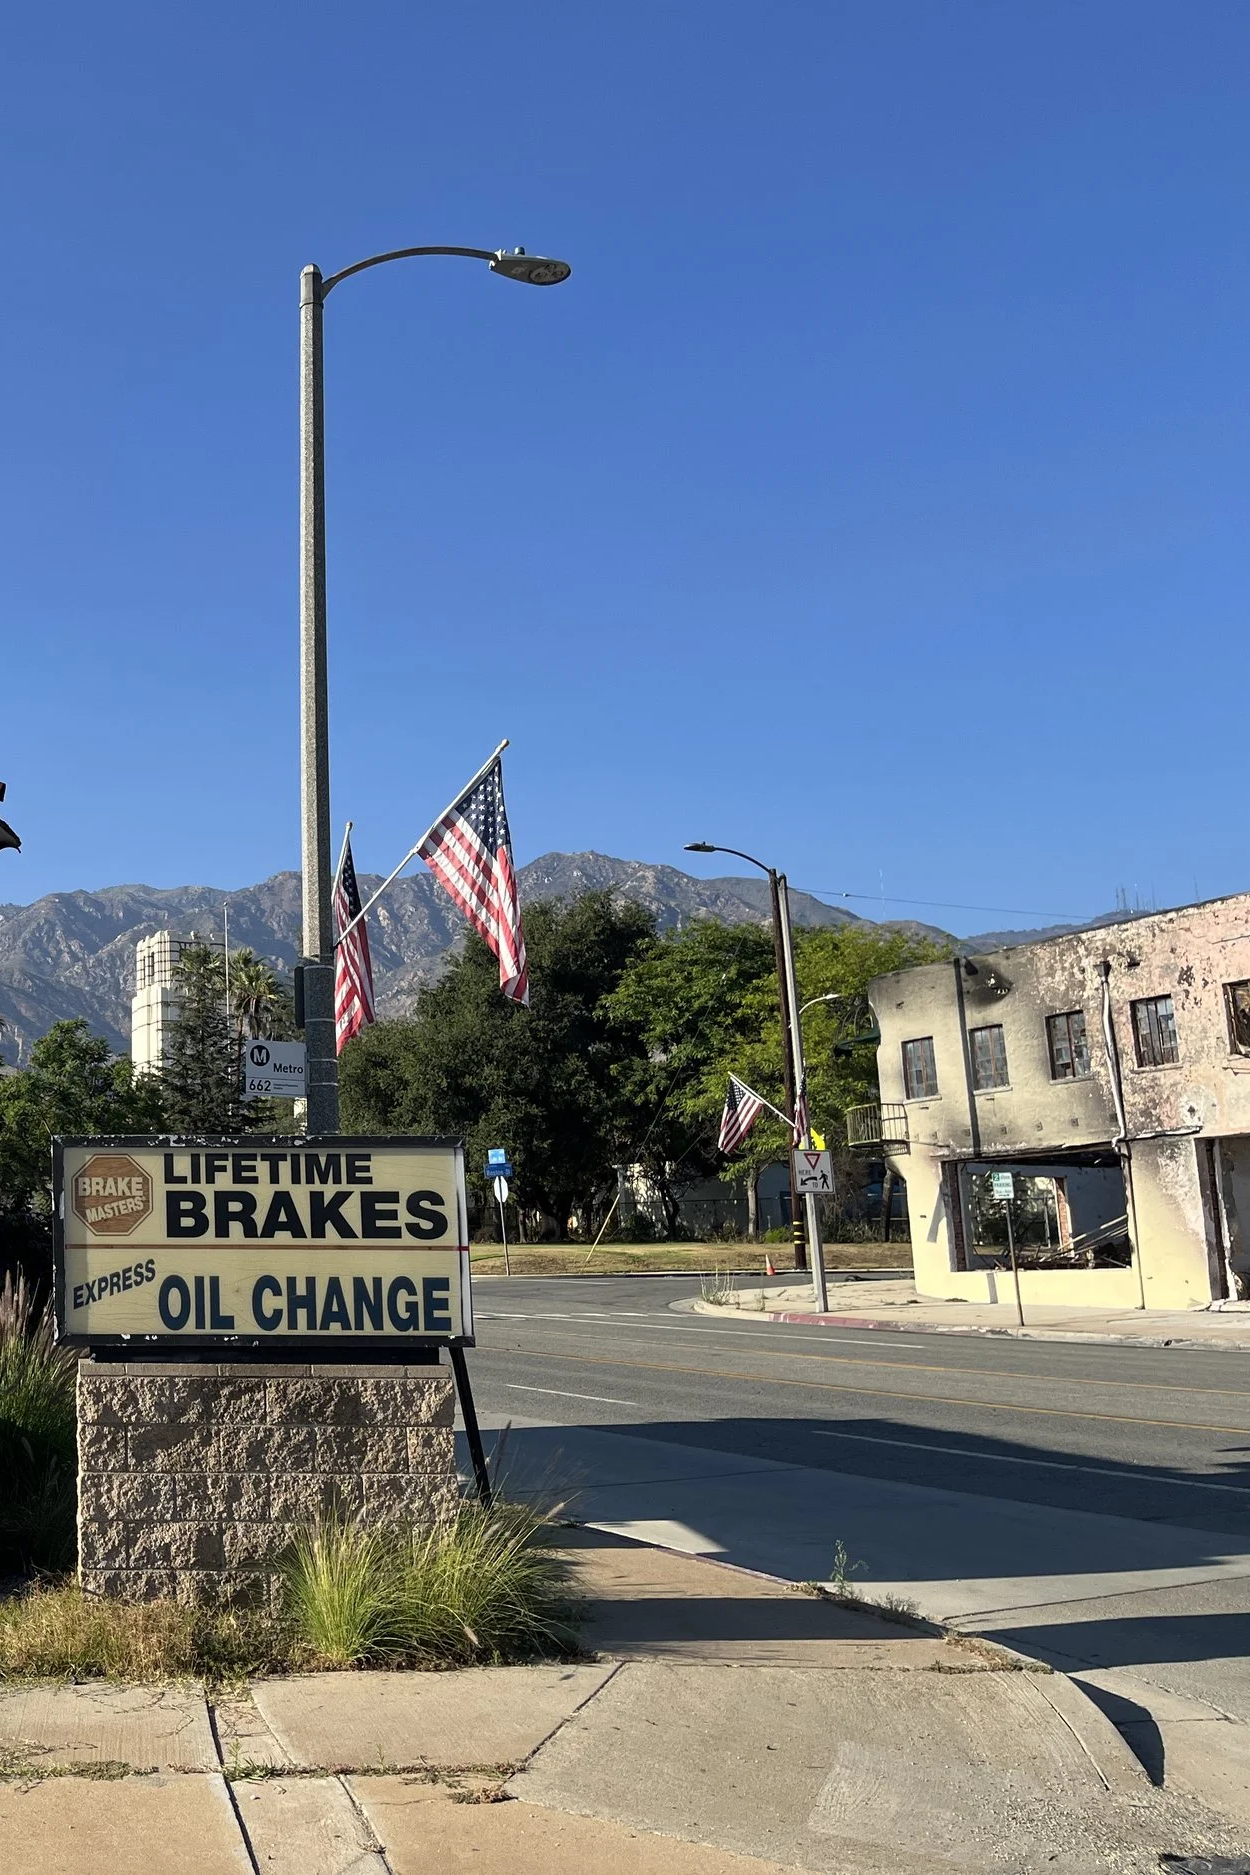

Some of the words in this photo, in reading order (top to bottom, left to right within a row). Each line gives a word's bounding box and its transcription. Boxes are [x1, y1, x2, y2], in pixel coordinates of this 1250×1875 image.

[253, 1048, 267, 1063] M
[273, 1063, 304, 1074] Metro
[249, 1079, 272, 1092] 662
[164, 1153, 373, 1185] LIFETIME
[78, 1176, 144, 1197] BRAKE
[166, 1190, 448, 1240] BRAKES
[73, 1258, 156, 1310] EXPRESS
[158, 1274, 235, 1331] OIL
[252, 1275, 452, 1332] CHANGE
